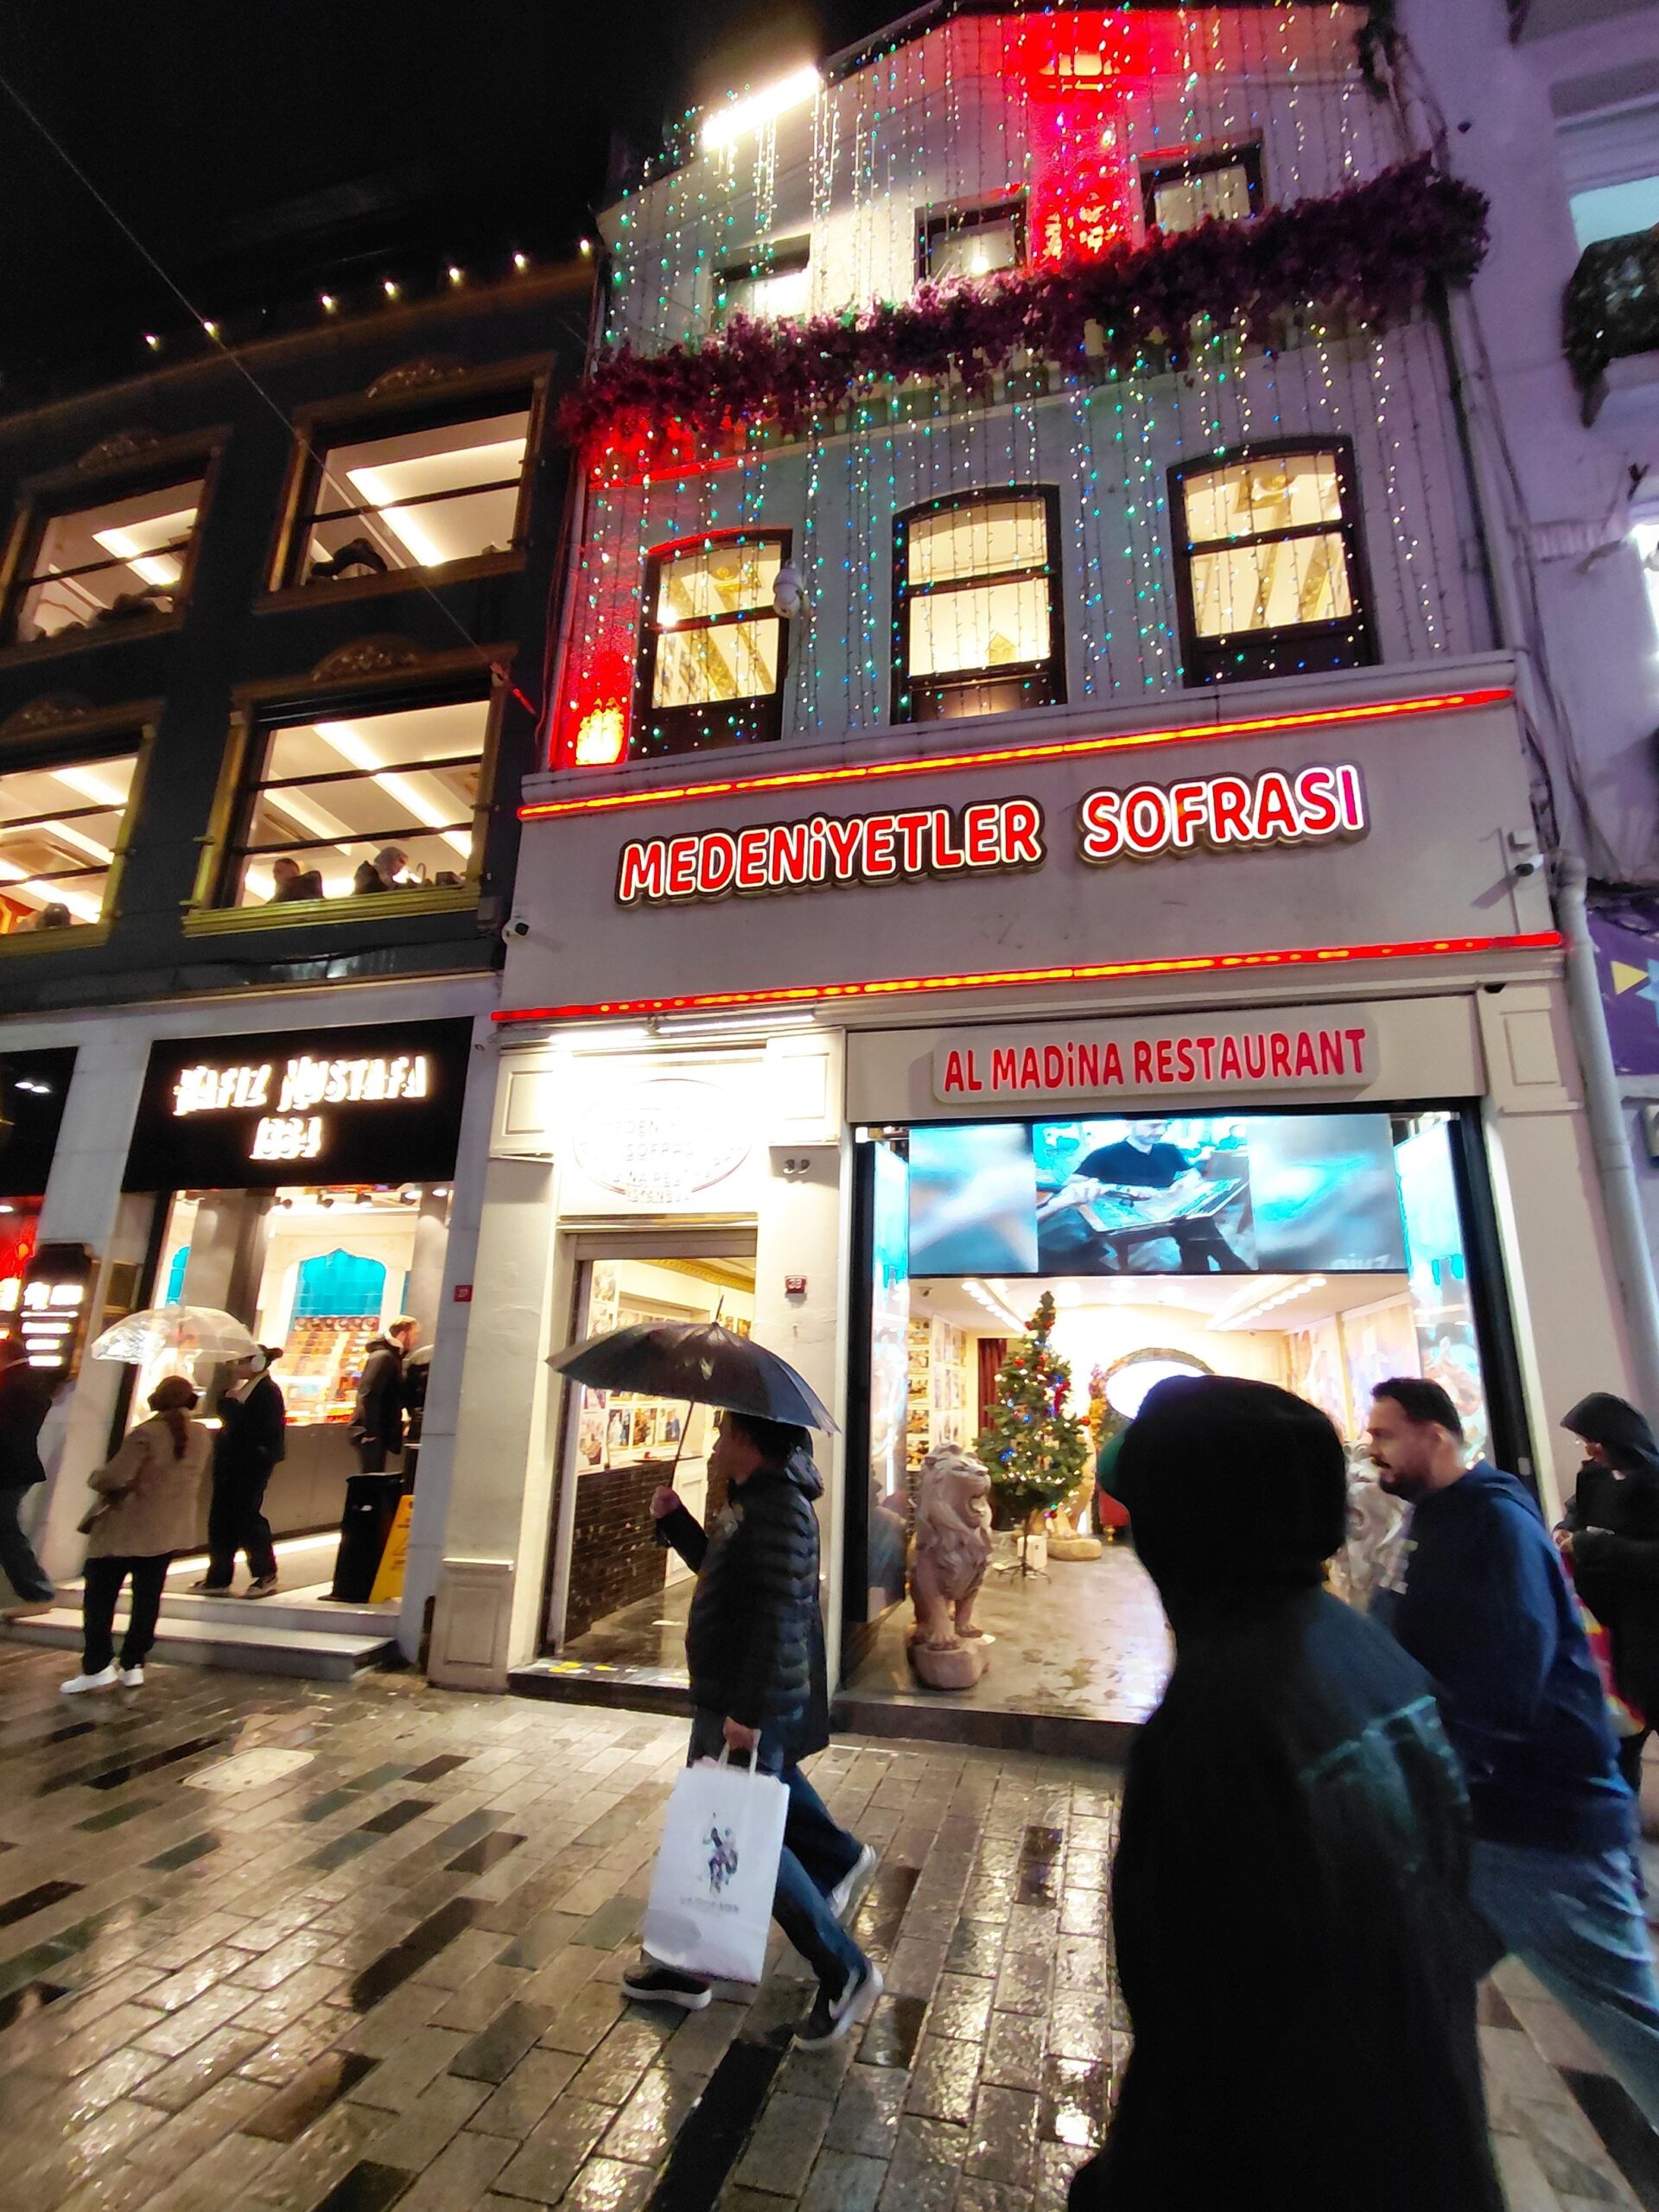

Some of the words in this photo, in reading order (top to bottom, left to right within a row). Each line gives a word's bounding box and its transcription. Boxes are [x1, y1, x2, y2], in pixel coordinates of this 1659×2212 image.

[1083, 764, 1365, 857] SOFRASI
[276, 1055, 428, 1113] MUSTAFA
[944, 1049, 982, 1092] AL
[1135, 1027, 1367, 1084] RESTAURANT
